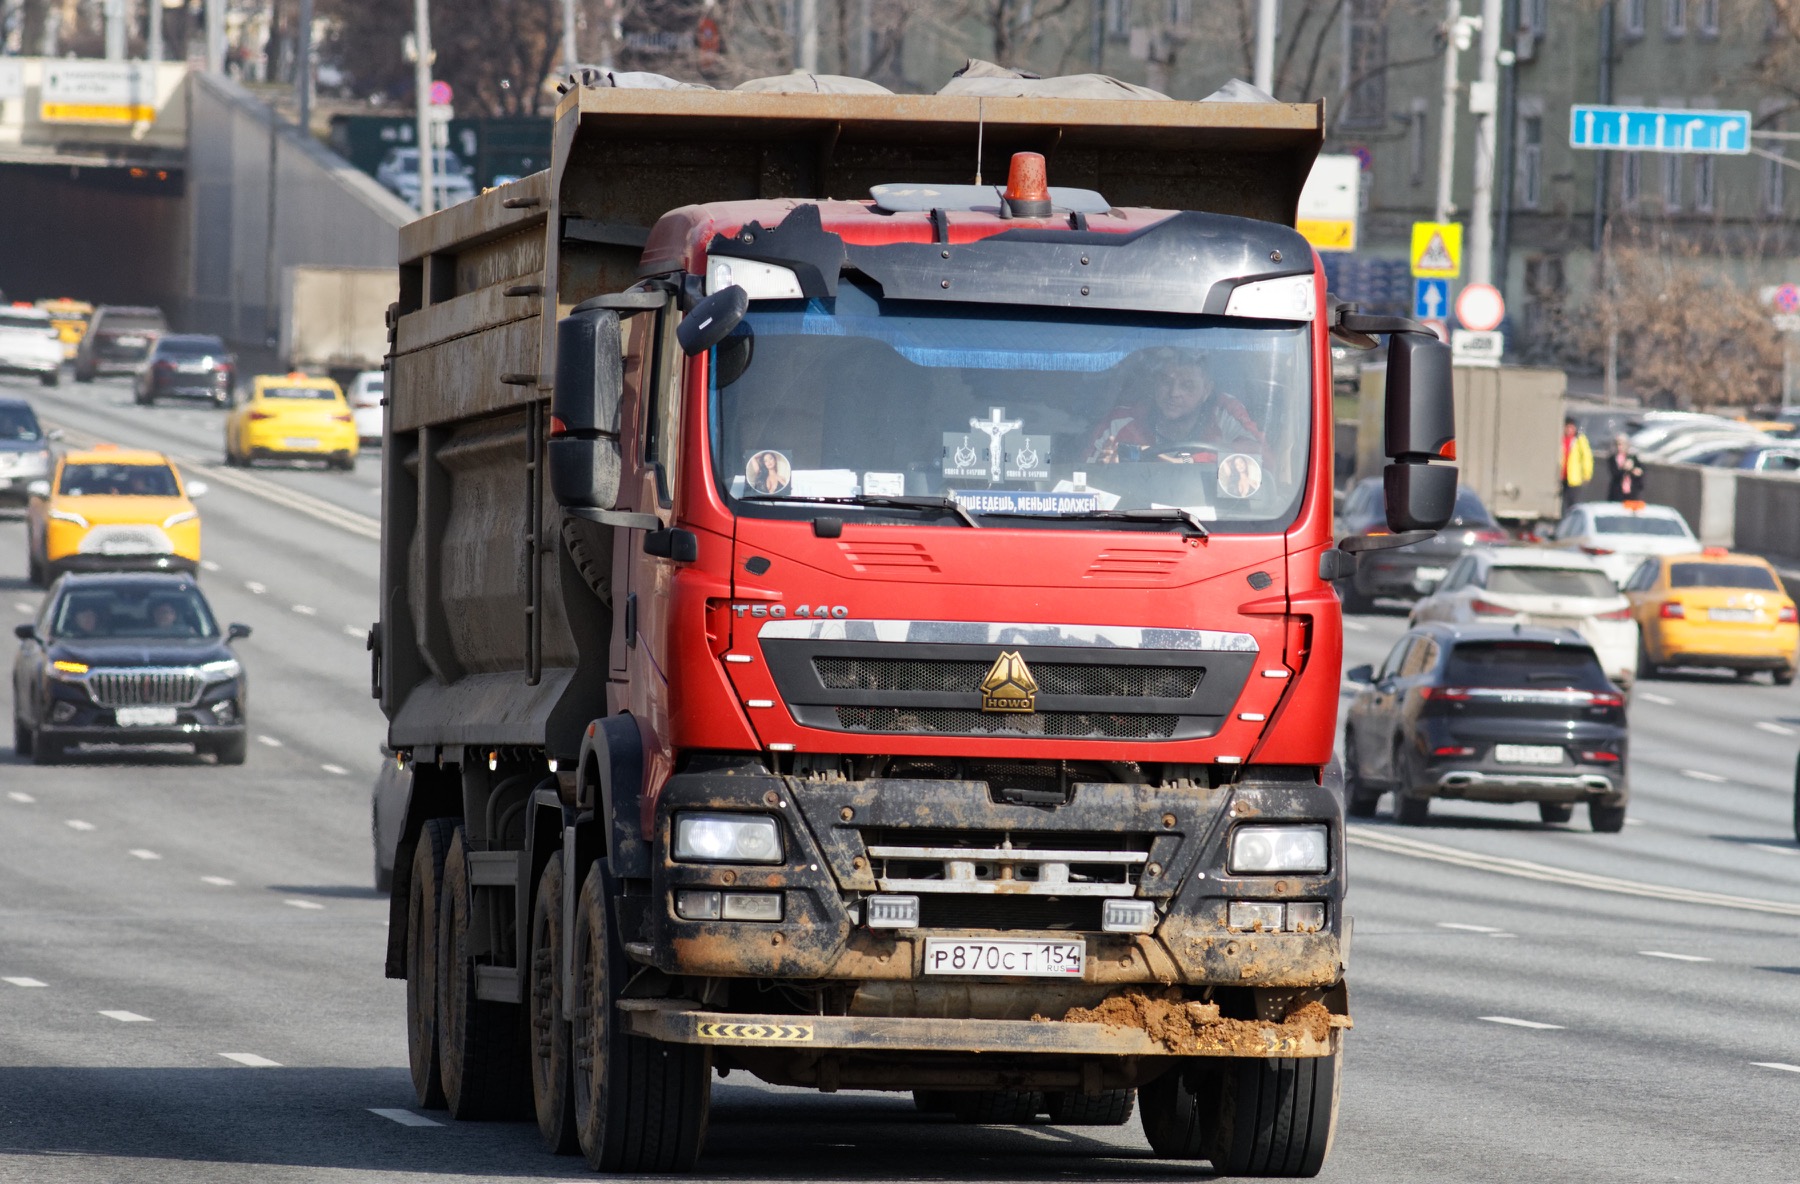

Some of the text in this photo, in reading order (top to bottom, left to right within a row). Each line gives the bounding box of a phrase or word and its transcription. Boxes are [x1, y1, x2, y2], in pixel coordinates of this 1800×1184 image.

[982, 496, 1017, 513] ЕДЕШЬ,
[1017, 496, 1058, 512] МЕНЬШЕ
[1057, 498, 1096, 514] ДОЛЖЕН
[732, 604, 849, 620] T5G 440
[987, 698, 1030, 708] HOWO
[1046, 964, 1066, 972] RUS
